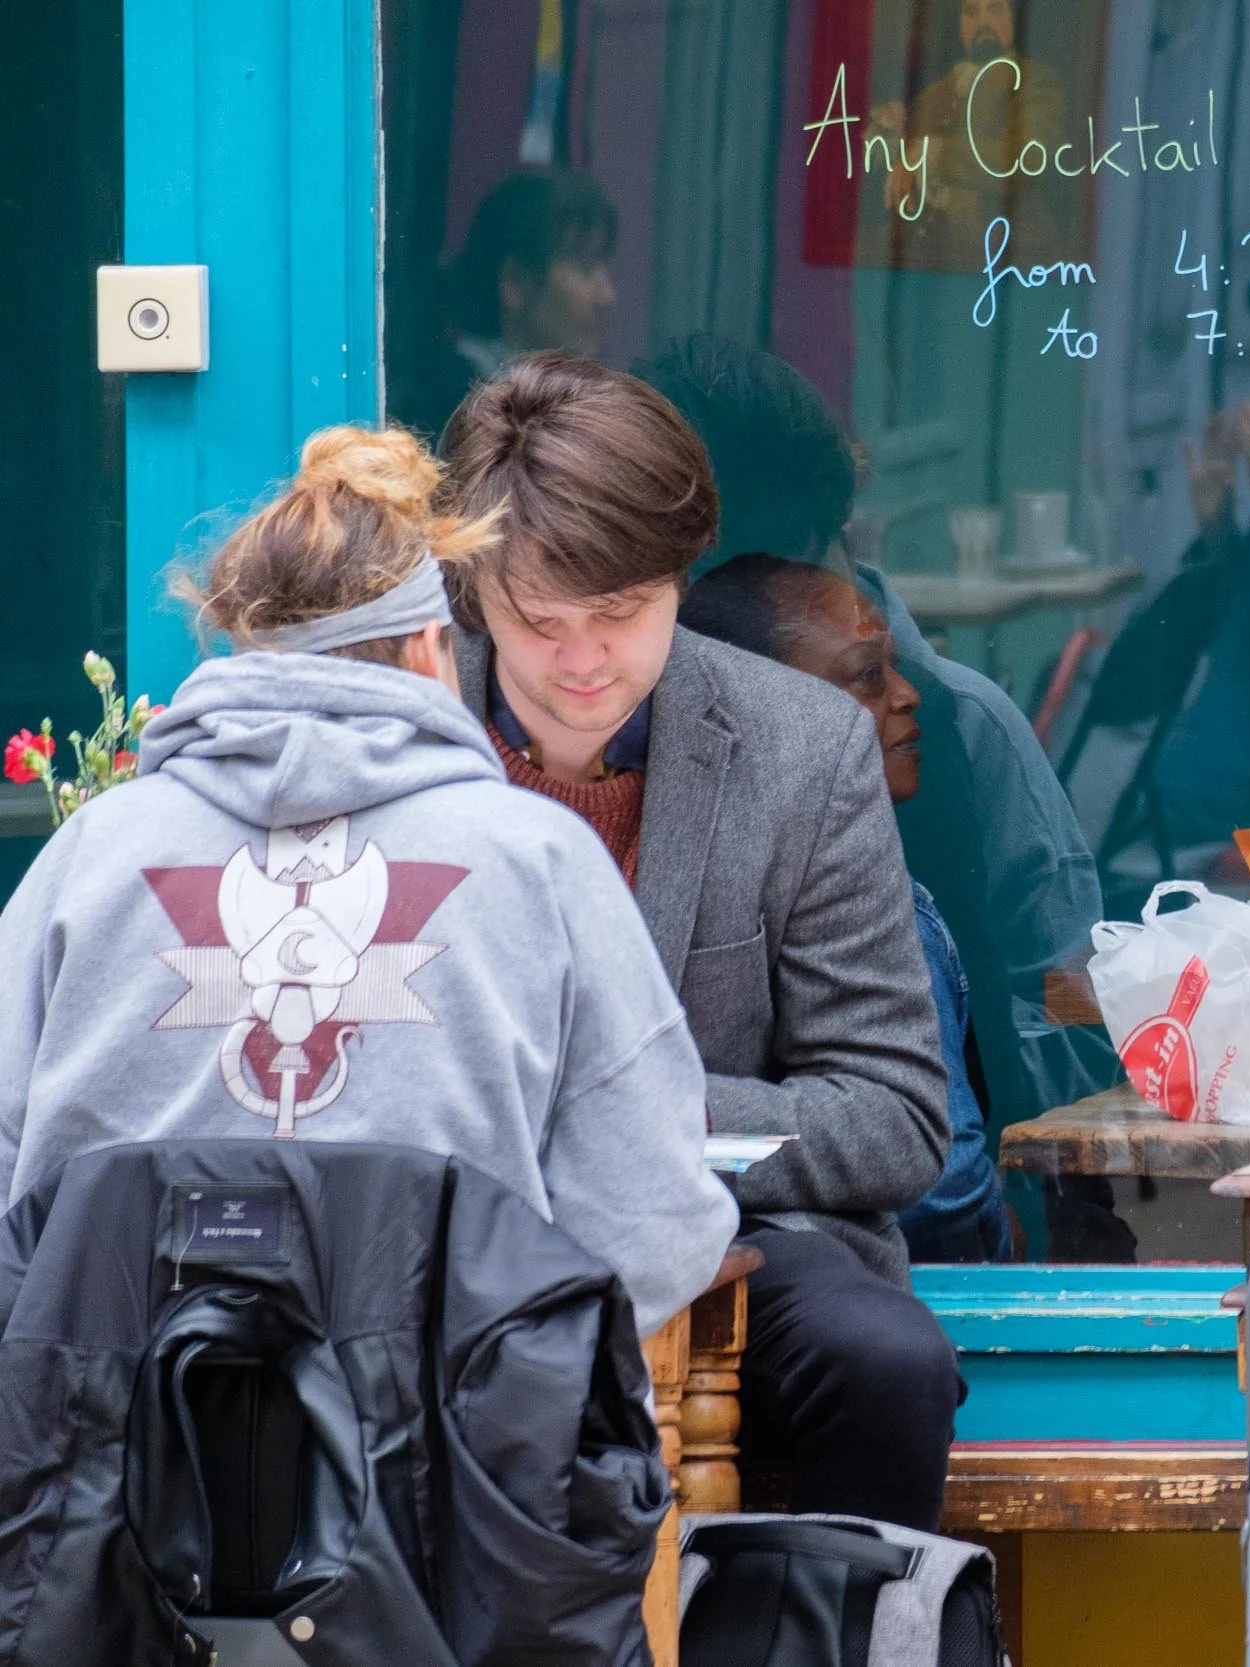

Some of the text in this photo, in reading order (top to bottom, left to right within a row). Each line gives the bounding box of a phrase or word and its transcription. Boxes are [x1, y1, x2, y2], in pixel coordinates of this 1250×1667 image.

[803, 62, 929, 221] Any
[966, 57, 1219, 178] Cocktail
[972, 216, 1098, 327] from
[1040, 307, 1099, 359] to
